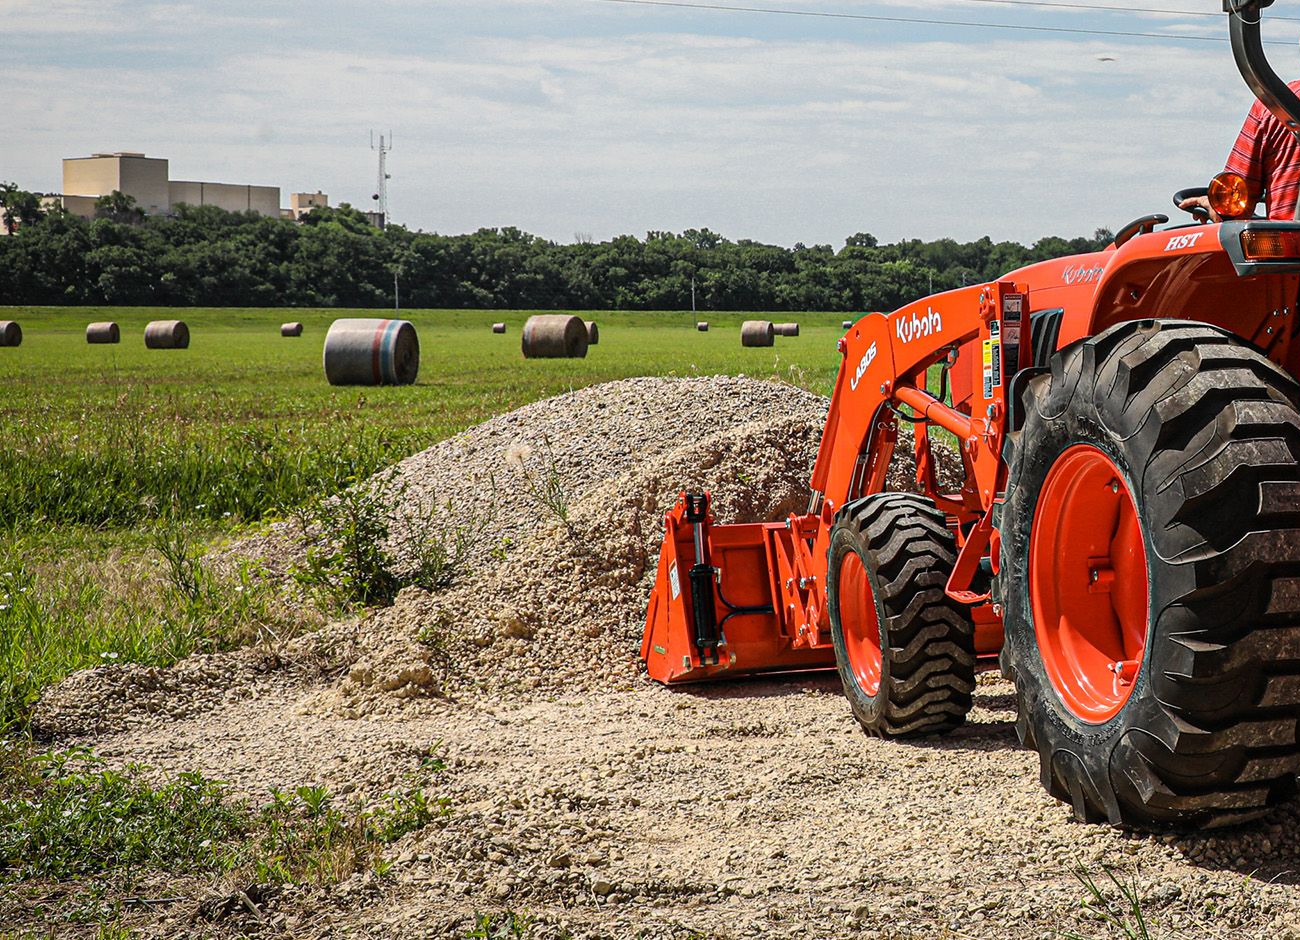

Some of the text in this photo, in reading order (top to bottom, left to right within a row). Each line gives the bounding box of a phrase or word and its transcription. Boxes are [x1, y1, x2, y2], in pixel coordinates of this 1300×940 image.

[1164, 232, 1204, 252] HST
[895, 306, 942, 343] Kubota
[850, 341, 877, 391] LA805
